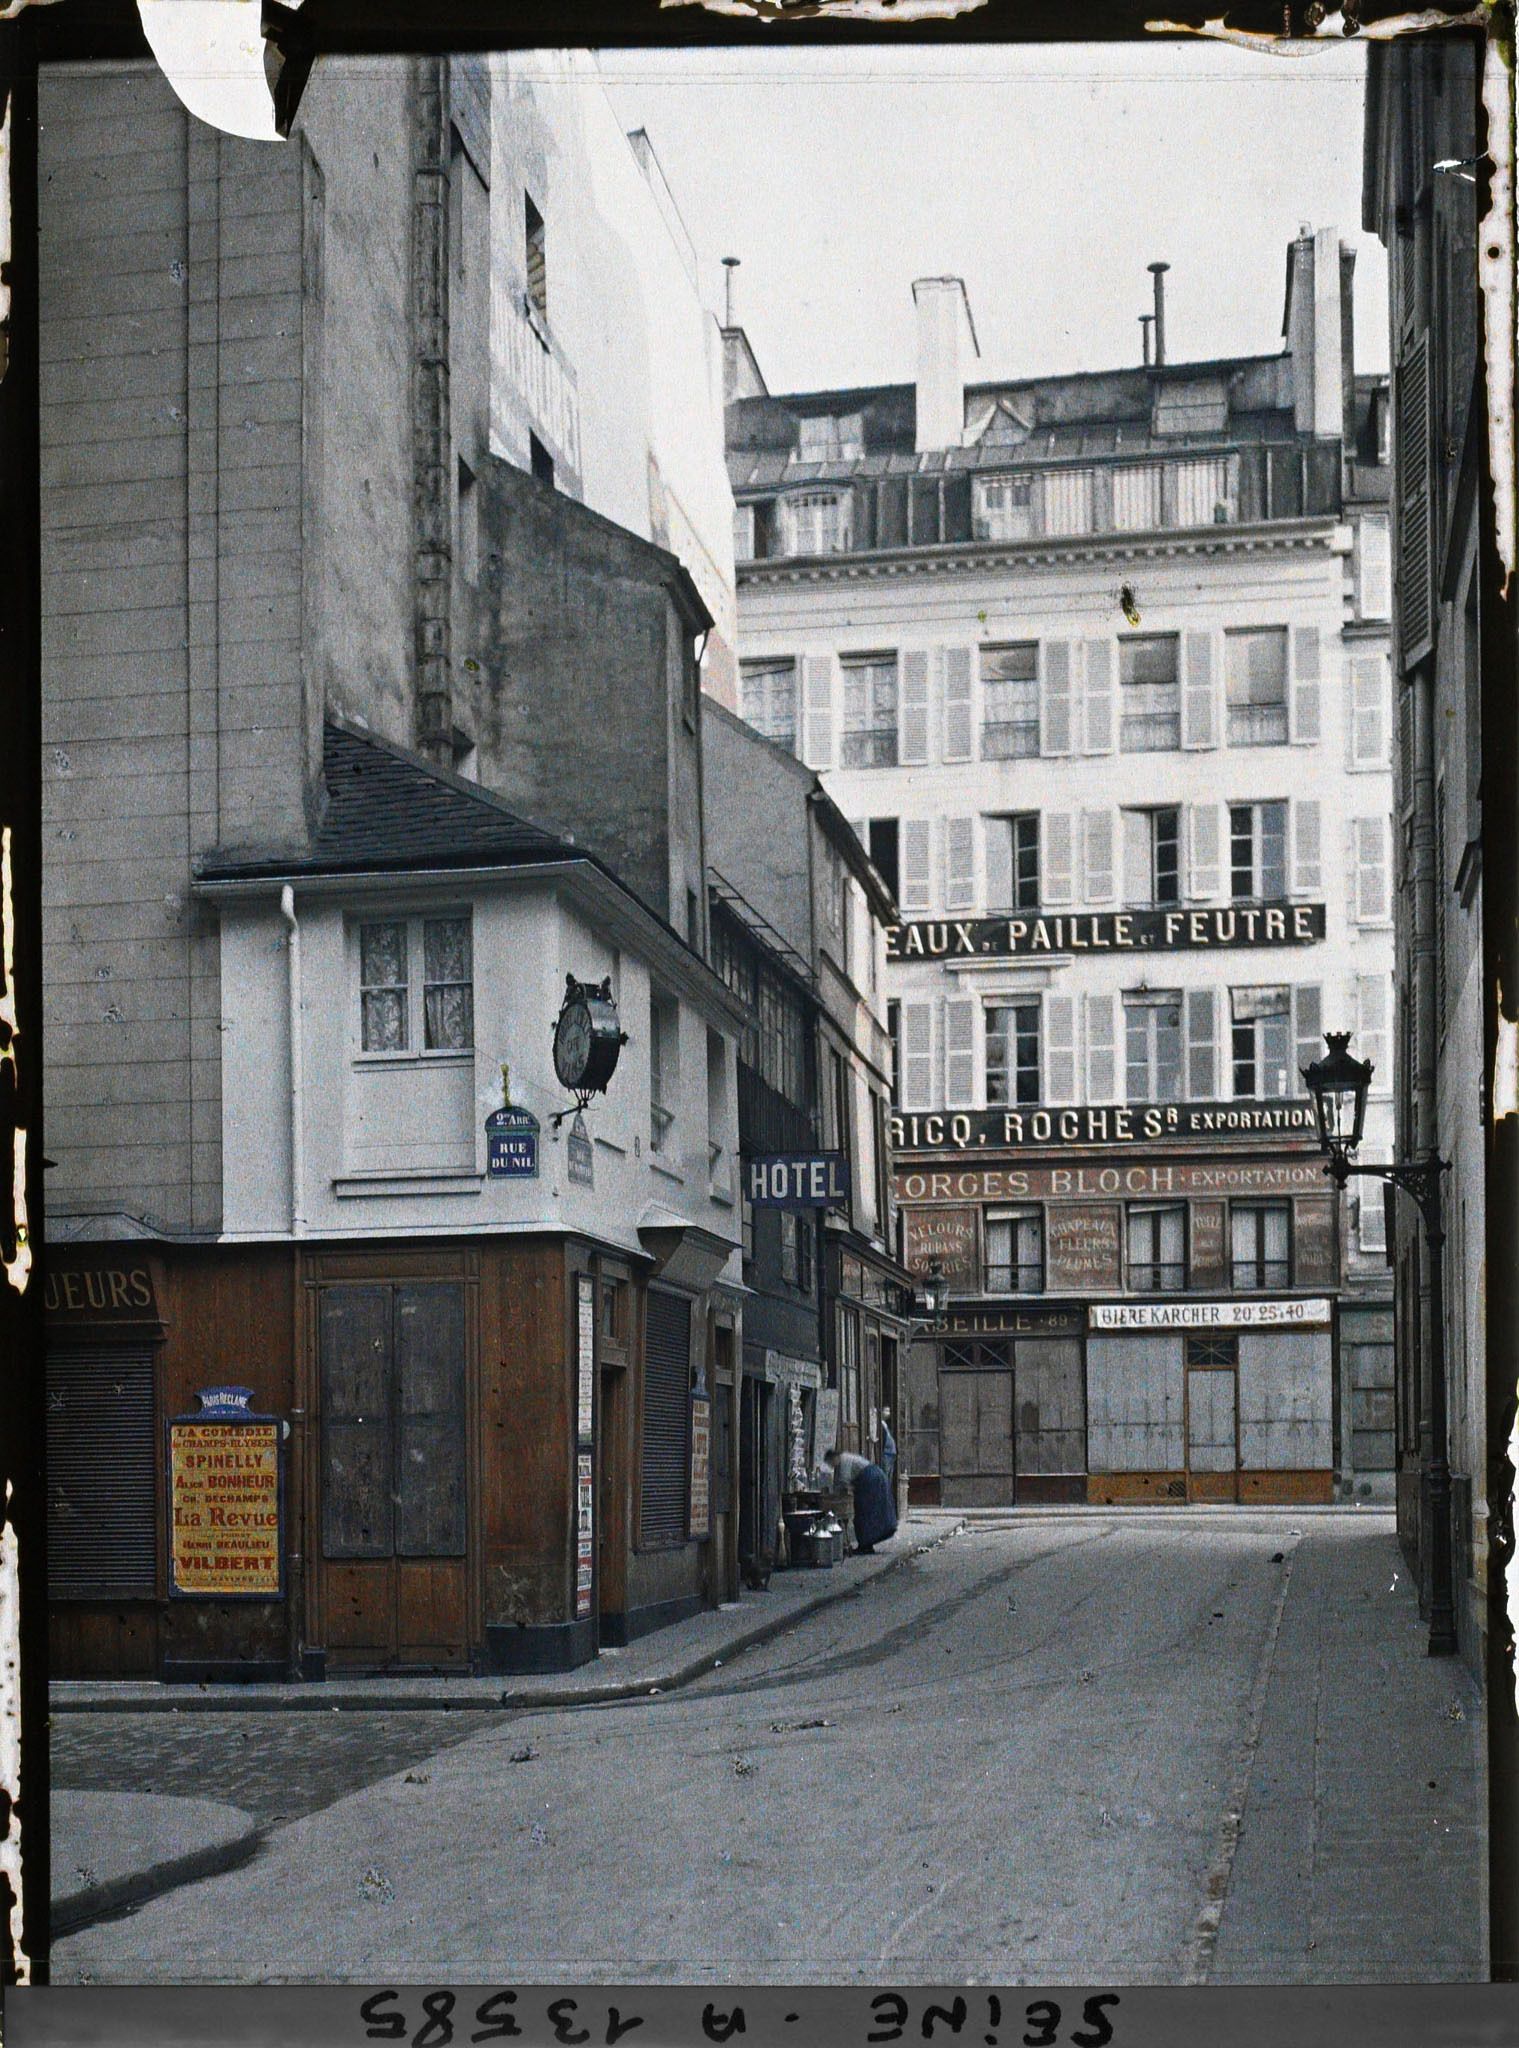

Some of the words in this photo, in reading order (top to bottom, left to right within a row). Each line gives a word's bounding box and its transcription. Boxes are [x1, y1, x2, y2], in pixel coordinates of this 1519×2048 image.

[1009, 914, 1134, 952] PAILLE
[1165, 906, 1315, 944] FEUTRE
[1005, 1108, 1135, 1142] ROCHE
[1190, 1108, 1315, 1130] EXPORTATION
[500, 1142, 527, 1154] RUE
[491, 1157, 508, 1169] DU
[511, 1157, 535, 1169] NIL
[751, 1158, 845, 1200] HÔTEL
[1051, 1167, 1174, 1196] BLOCH
[1192, 1167, 1317, 1187] EXPORTATION
[908, 1222, 974, 1240] VELOURS
[919, 1241, 962, 1254] RUBANS
[911, 1255, 972, 1274] SORIES
[1151, 1306, 1221, 1324] KARCHER
[176, 1427, 197, 1438] LA
[184, 1454, 263, 1469] SPINELLY
[207, 1475, 275, 1489] BONHEUR
[174, 1507, 202, 1527] La
[209, 1507, 278, 1527] Revue
[179, 1556, 276, 1570] VILBERT
[359, 1988, 645, 2048] 13585
